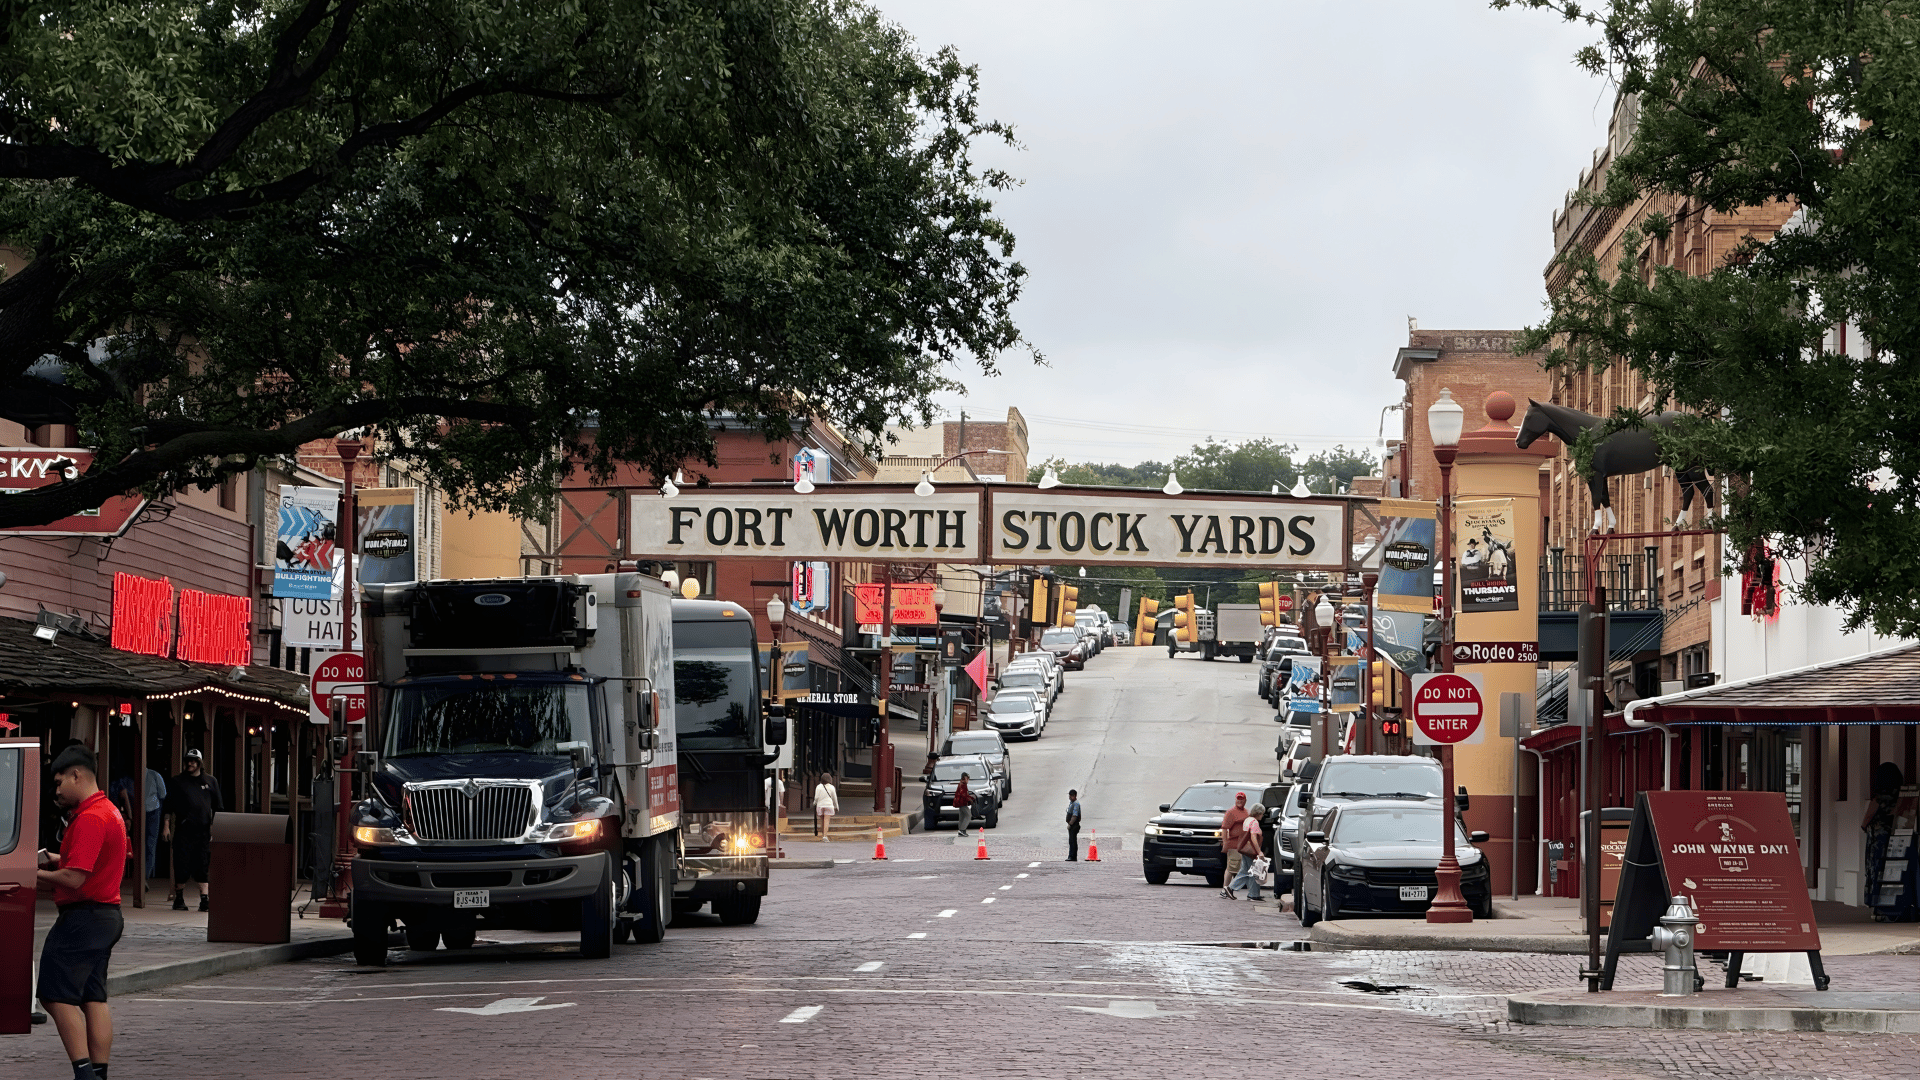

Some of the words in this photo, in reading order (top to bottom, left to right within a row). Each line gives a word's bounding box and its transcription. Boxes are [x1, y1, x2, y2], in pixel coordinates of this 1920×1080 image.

[668, 507, 792, 546] FORT
[813, 508, 966, 548] WORTH
[1002, 510, 1147, 552] STOCK
[1171, 514, 1317, 556] YARDS
[1386, 550, 1404, 559] WORLD
[1408, 552, 1428, 561] FINALS
[275, 572, 332, 583] BULLFIGHTING
[1463, 585, 1516, 595] THURSDAYS
[1279, 600, 1292, 608] STOP
[307, 620, 358, 642] HATS
[1473, 643, 1515, 660] Rodeo
[1522, 643, 1533, 653] Plz
[1518, 652, 1538, 662] 2500
[322, 667, 339, 678] DO
[347, 667, 363, 678] NO
[905, 684, 920, 692] Main
[1424, 688, 1440, 700] DO
[1447, 687, 1472, 699] NOT
[327, 698, 365, 709] EER
[834, 693, 858, 704] STORE
[1429, 718, 1468, 731] ENTER
[1672, 845, 1705, 854] JOHN
[1711, 845, 1755, 854] WAYNE
[1761, 845, 1788, 854] DAY!
